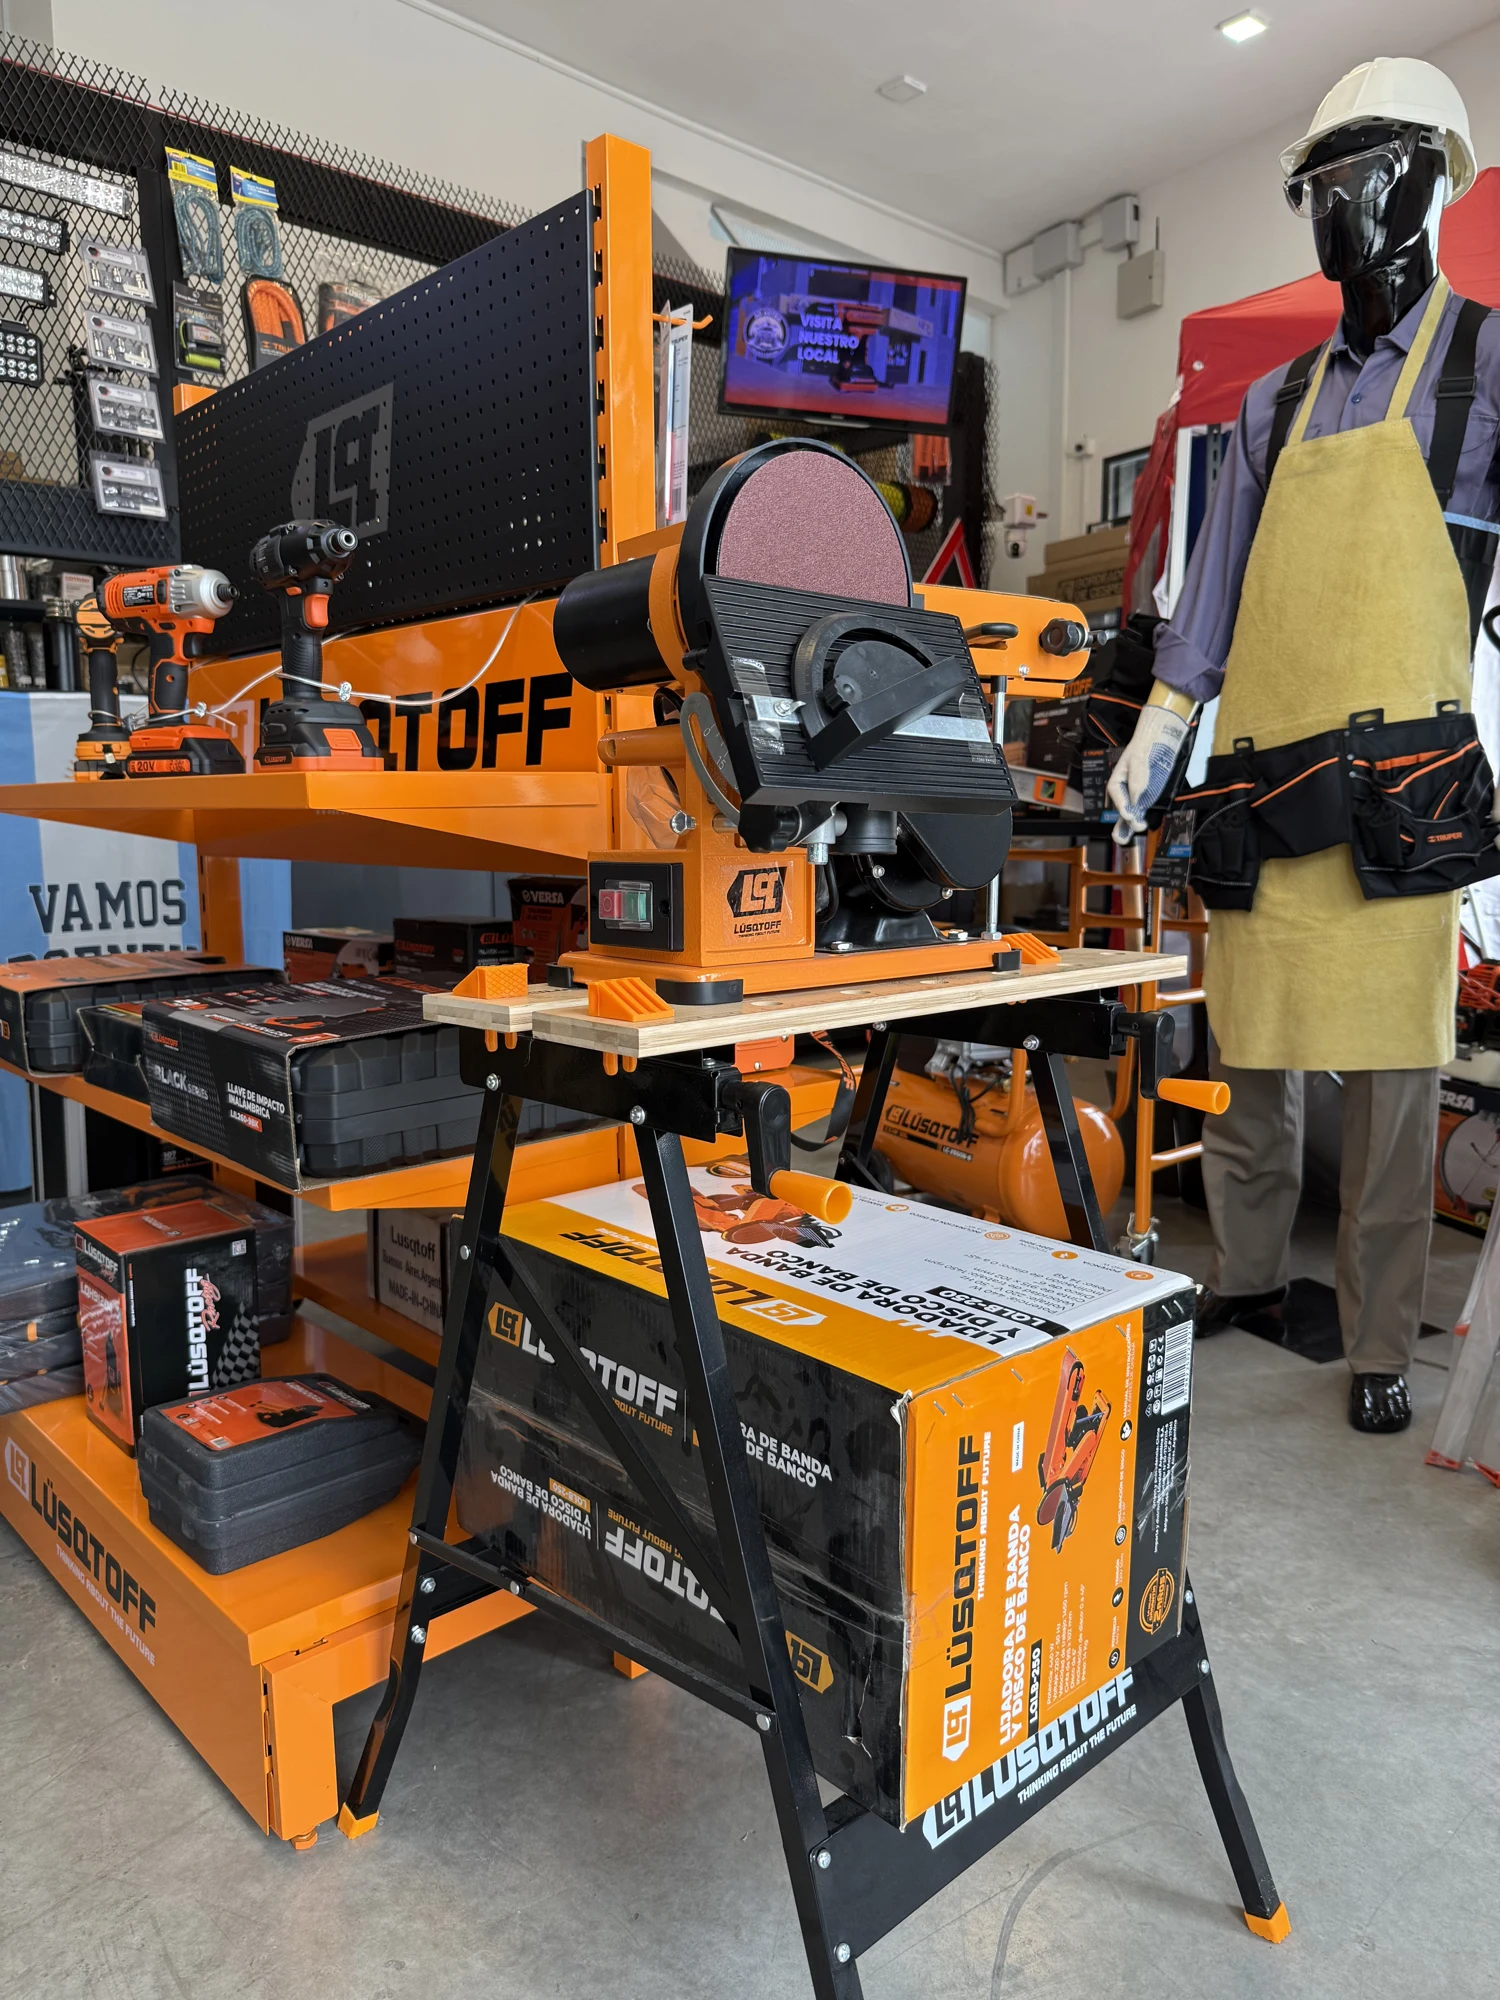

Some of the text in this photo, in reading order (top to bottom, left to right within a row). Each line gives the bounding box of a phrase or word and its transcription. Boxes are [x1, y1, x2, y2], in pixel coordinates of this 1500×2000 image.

[799, 330, 859, 349] NUESTRO
[800, 313, 842, 331] VISITA
[797, 347, 840, 364] LOCAL
[137, 761, 155, 772] 20V
[29, 879, 187, 934] VAMOS
[530, 891, 564, 905] VERSA
[291, 938, 313, 950] VERSA
[154, 1065, 208, 1100] BLACK SERIES
[227, 1082, 285, 1114] LLAVE DE IMPACTO
[1439, 1090, 1475, 1111] ERSA
[391, 1225, 436, 1262] Lusqtoff
[726, 1247, 816, 1279] BANDA
[766, 1250, 1022, 1339] Y DISCO DE BANCO
[810, 1277, 856, 1293] DE
[984, 1289, 1006, 1297] 440
[1021, 1288, 1075, 1307] Velocidad
[1026, 1295, 1065, 1310] Voltaje:
[1045, 1276, 1104, 1296] Inclinación
[1056, 1292, 1085, 1303] Cinta
[1064, 1288, 1095, 1300] Disco
[1082, 1281, 1113, 1293] Peso:
[856, 1290, 1008, 1345] LIJADORA
[938, 1290, 1047, 1327] LQLB-250
[1007, 1296, 1058, 1314] Potencia:
[186, 1267, 210, 1390] LÜSQTOFF
[638, 1412, 673, 1437] FUTURE
[746, 1442, 817, 1489] DE BANCO
[759, 1435, 834, 1482] DE BANDA
[490, 1470, 591, 1540] LIJADORA DE BANDA
[500, 1465, 592, 1528] Y DISCO DE BANCO
[607, 1508, 672, 1554] ABOUT FUTURE
[977, 1431, 991, 1601] THINKING ABOUT FUTURE
[31, 1461, 156, 1633] LÜSQTOFF
[945, 1436, 981, 1698] LÜSQTOFF
[56, 1543, 156, 1667] THINKING ABOUT THE FUTURE
[999, 1504, 1020, 1746] LIJADORA DE BANDA
[1011, 1524, 1031, 1739] Y DISCO DE BANCO
[1029, 1647, 1041, 1724] LQLB-250
[1017, 1703, 1137, 1804] THINKING ABOUT THE FUTURE
